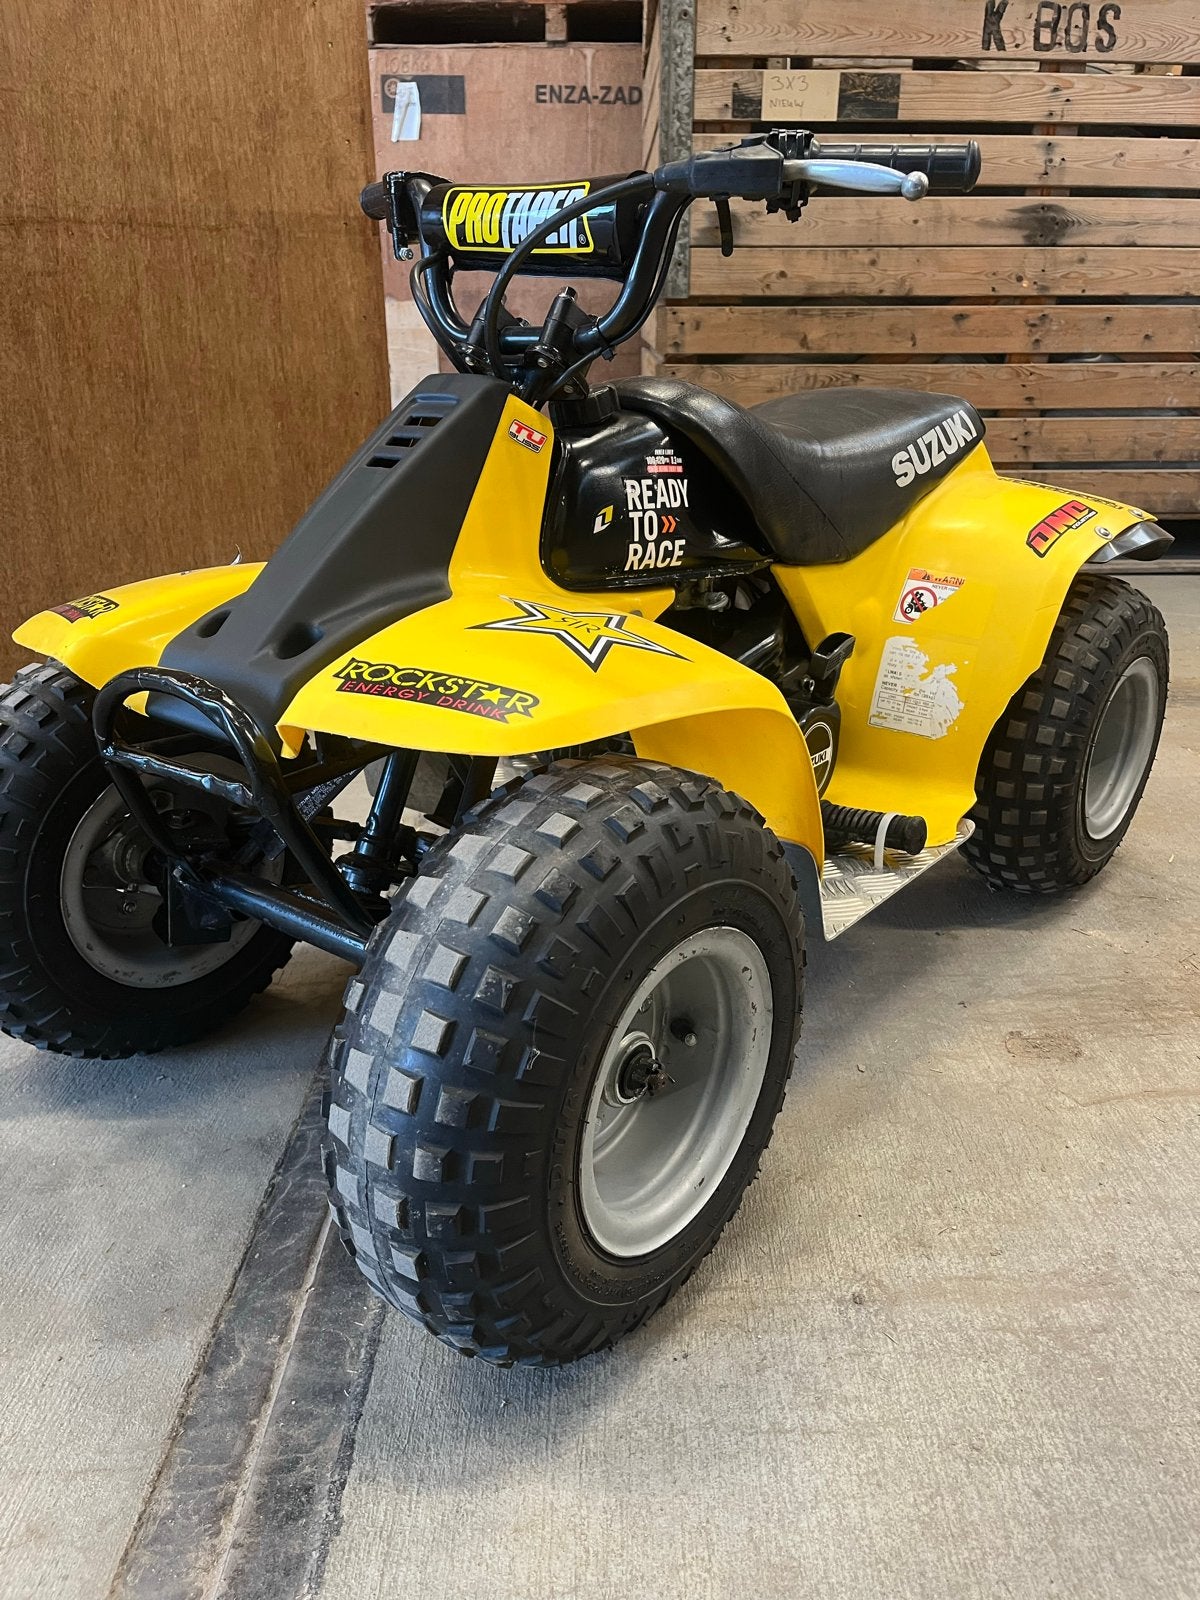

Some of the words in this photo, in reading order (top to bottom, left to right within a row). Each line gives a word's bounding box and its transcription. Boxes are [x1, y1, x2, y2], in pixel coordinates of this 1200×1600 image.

[1033, 1, 1121, 53] BOS
[535, 84, 643, 105] ENZA-ZAD
[891, 409, 978, 488] SUZUKI
[625, 478, 689, 511] READY
[628, 510, 658, 542] TO
[624, 539, 686, 572] RACE
[342, 680, 431, 700] ENERGY
[436, 695, 508, 720] DRINK
